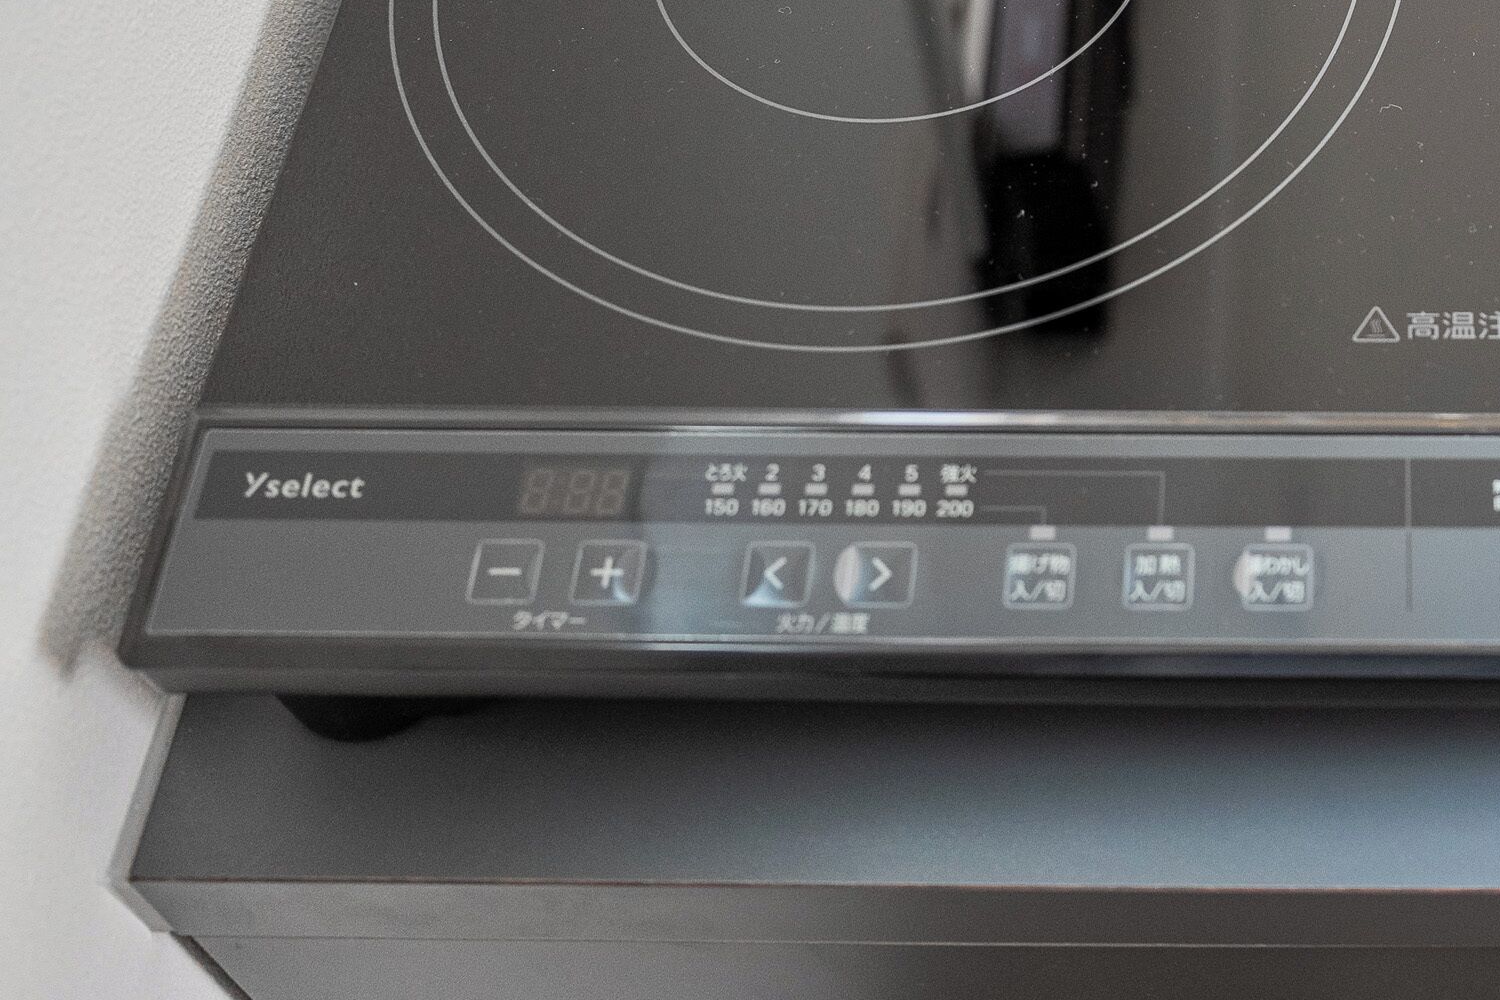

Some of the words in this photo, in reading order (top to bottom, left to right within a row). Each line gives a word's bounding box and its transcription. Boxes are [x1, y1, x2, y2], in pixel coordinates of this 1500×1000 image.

[765, 463, 780, 482] 2
[811, 463, 827, 482] 3
[857, 463, 873, 482] 4
[905, 463, 920, 483] 5
[244, 471, 366, 499] Yselect
[705, 497, 740, 517] 150
[751, 497, 787, 517] 160
[798, 497, 834, 518] 170
[845, 497, 881, 518] 180
[892, 497, 927, 518] 190
[936, 498, 975, 518] 200
[513, 610, 587, 631] タイマー
